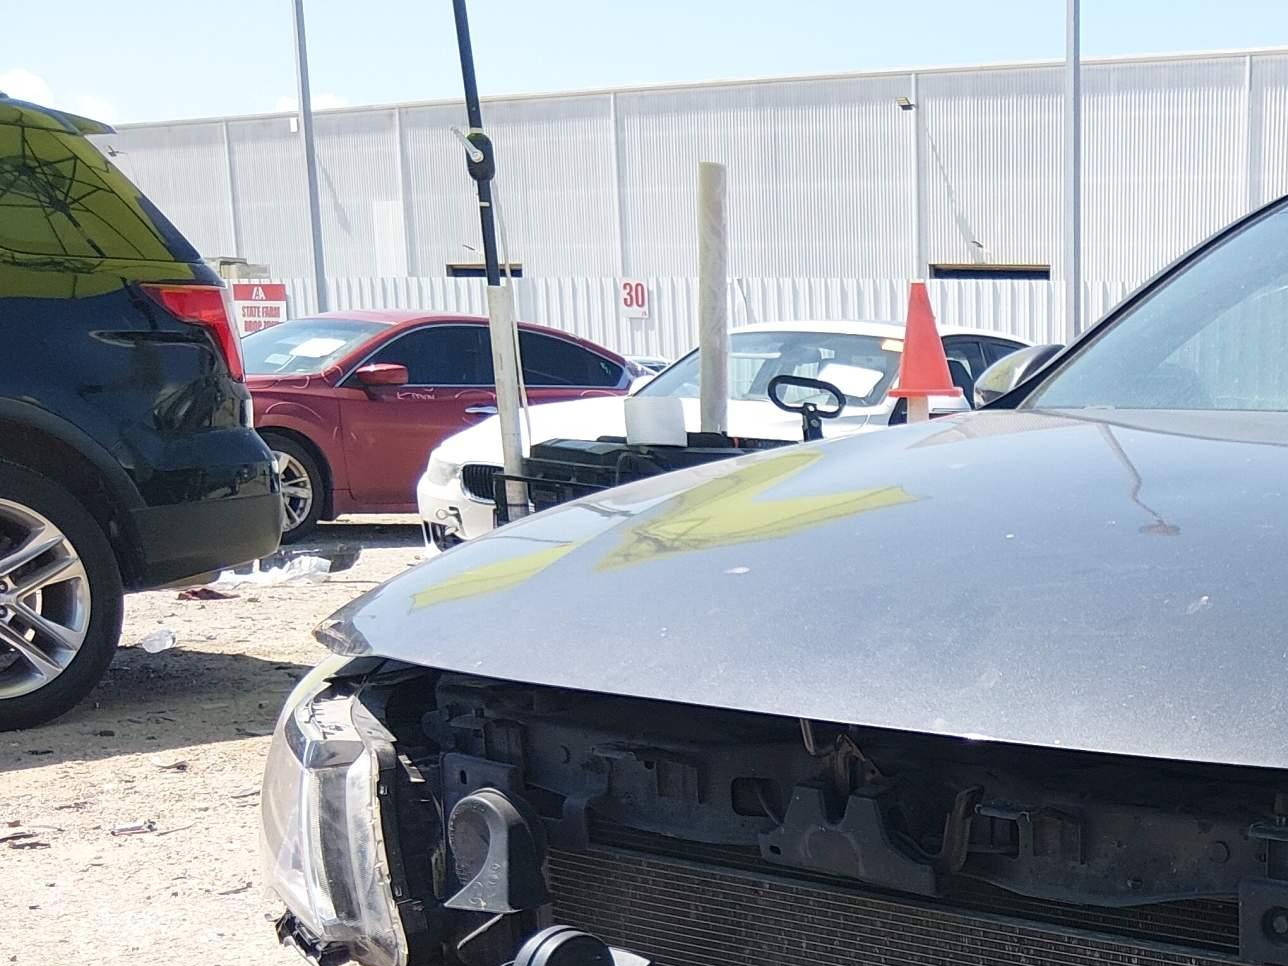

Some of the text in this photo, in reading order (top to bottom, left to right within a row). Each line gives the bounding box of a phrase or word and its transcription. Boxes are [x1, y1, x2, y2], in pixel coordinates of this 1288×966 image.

[622, 282, 645, 308] 30
[241, 305, 281, 318] STATE FARM
